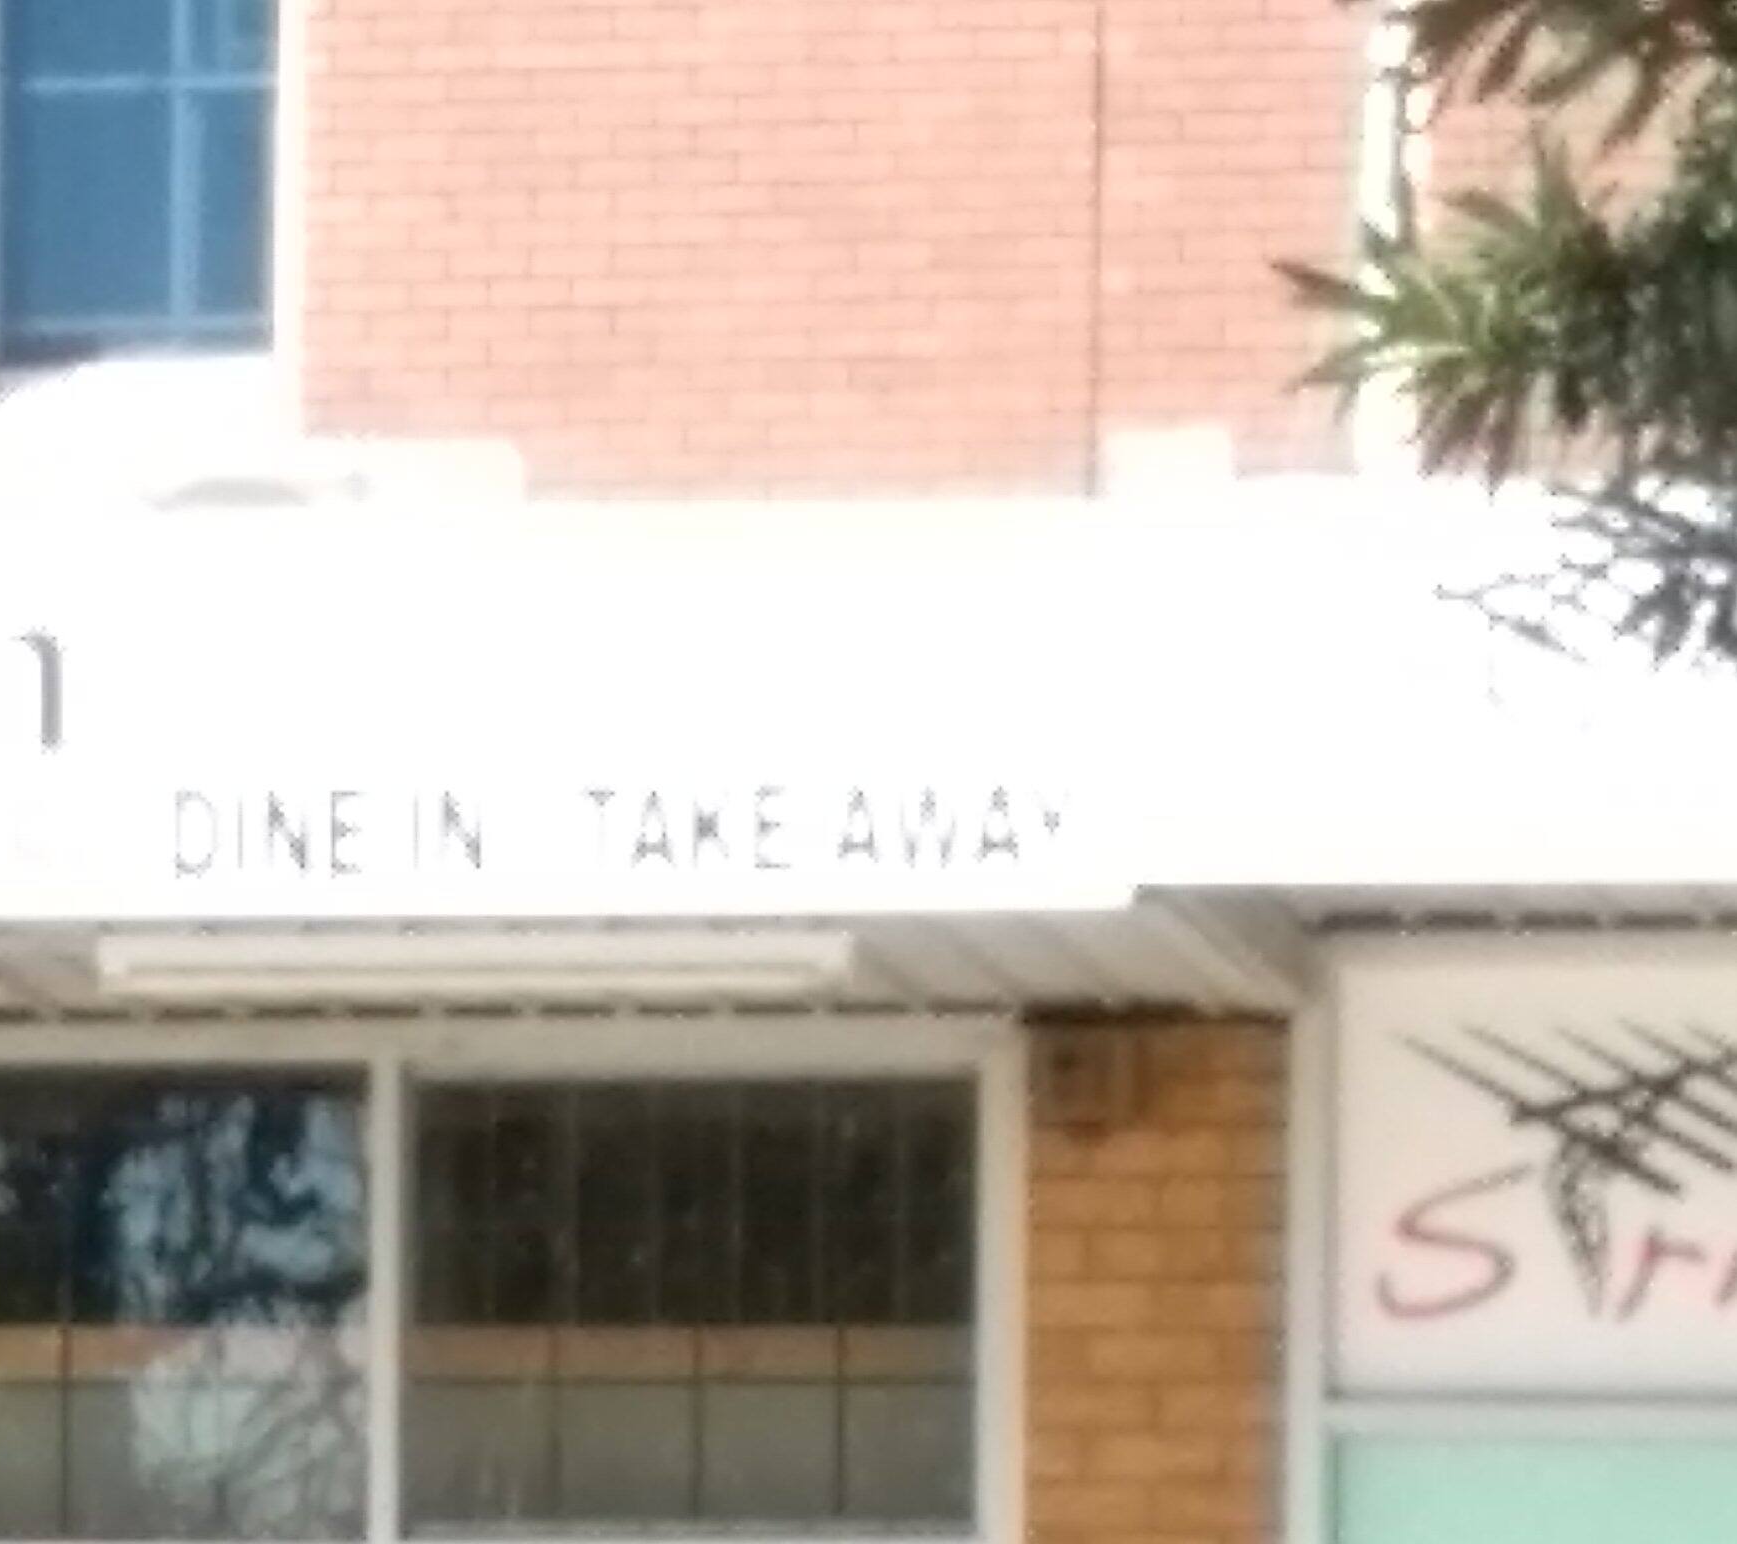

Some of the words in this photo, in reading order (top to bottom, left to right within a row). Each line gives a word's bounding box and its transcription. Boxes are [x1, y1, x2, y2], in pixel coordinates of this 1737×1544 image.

[174, 789, 365, 880] DINE
[412, 789, 484, 870] IN
[581, 786, 791, 870] TAKE
[835, 786, 1070, 868] AWAY
